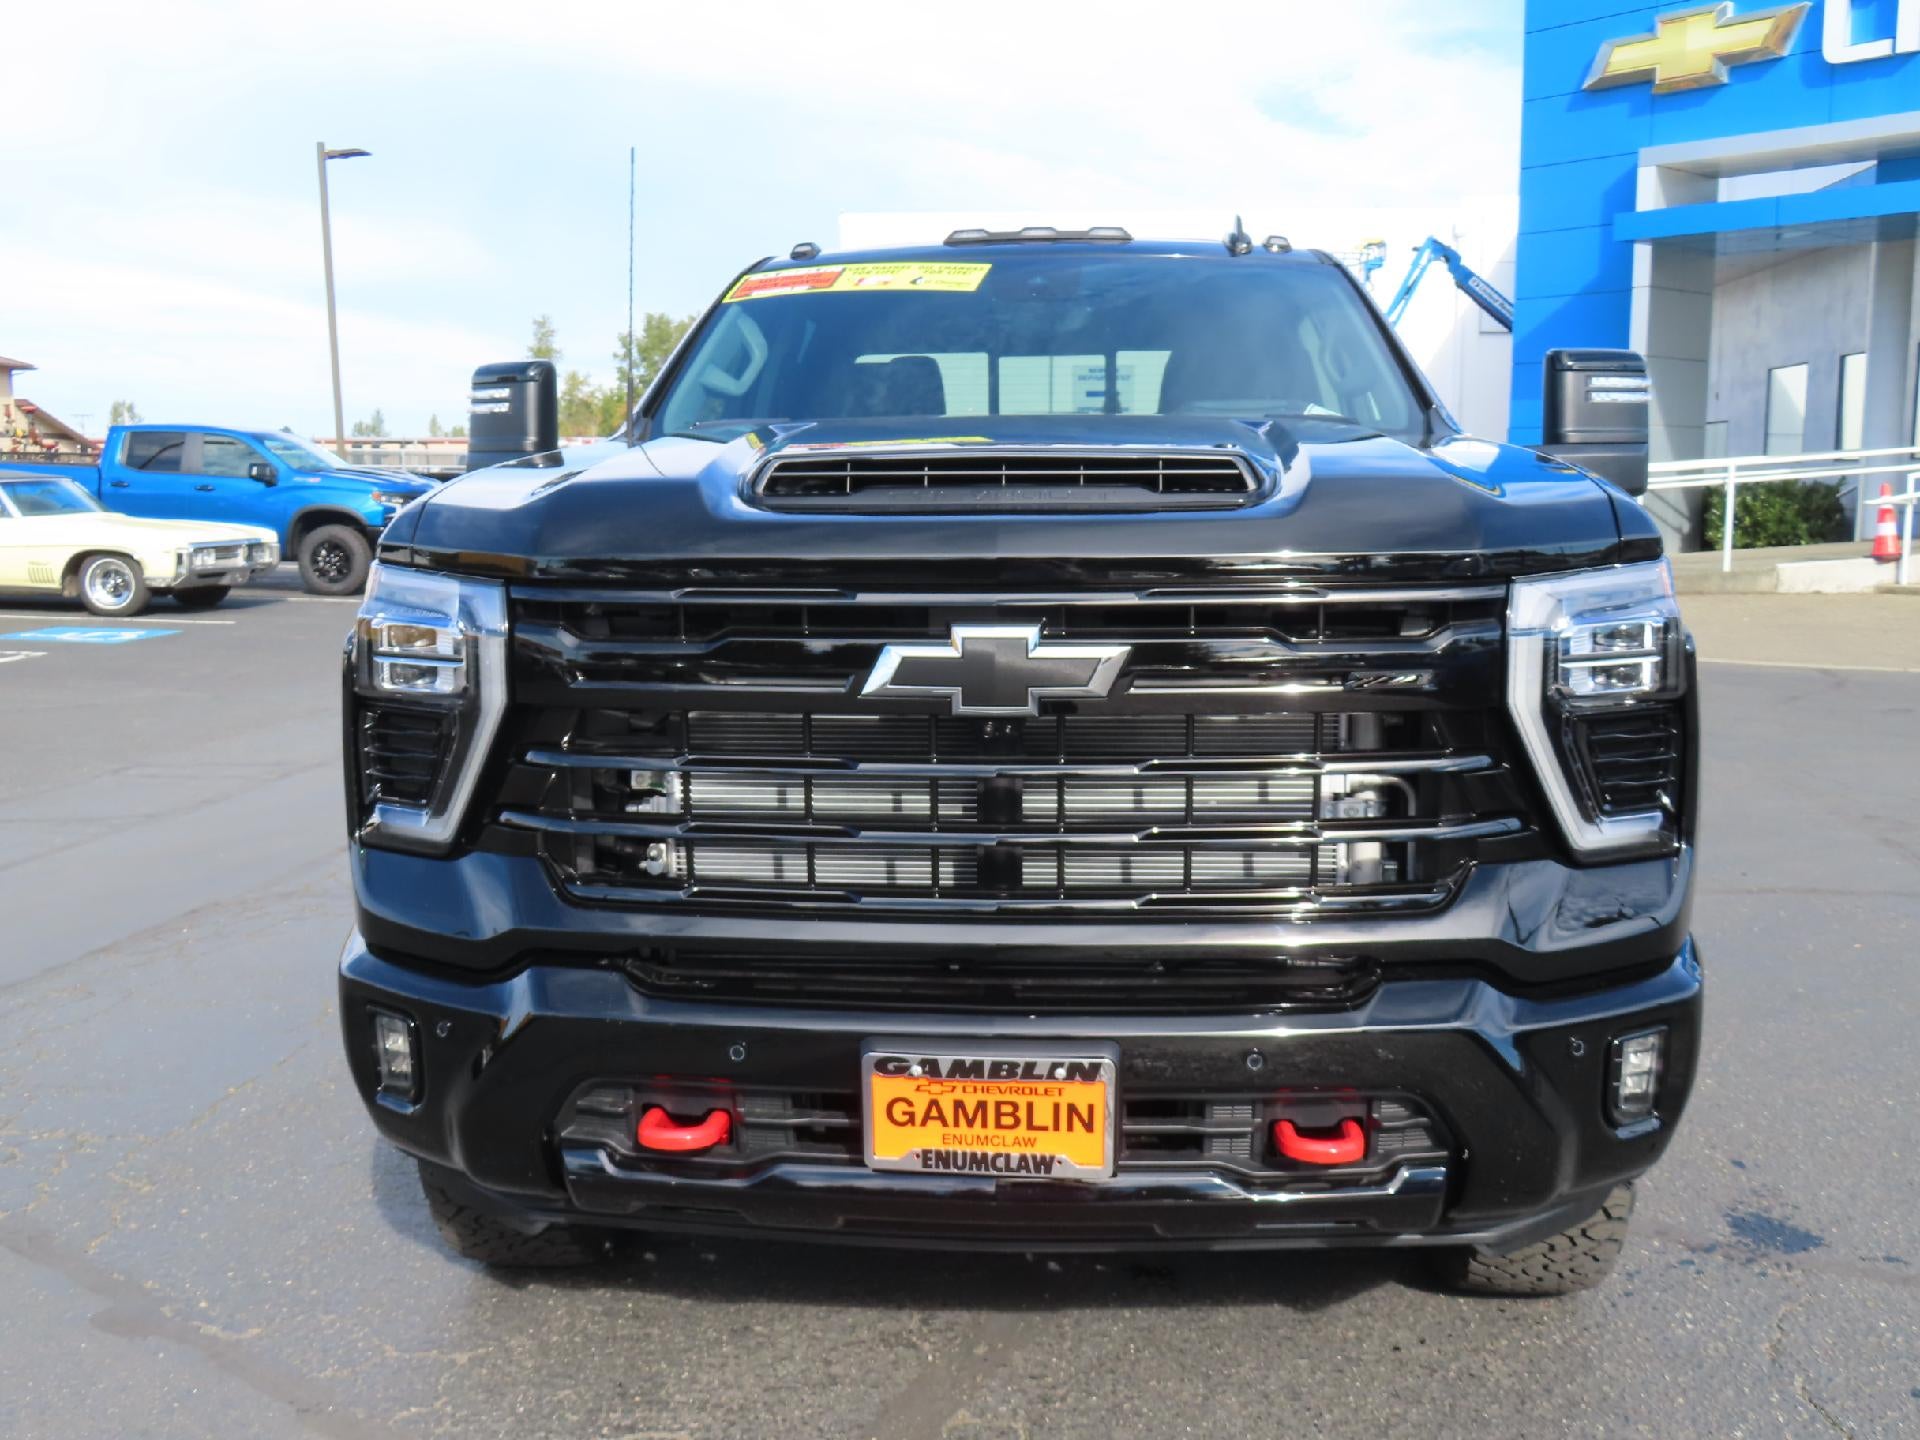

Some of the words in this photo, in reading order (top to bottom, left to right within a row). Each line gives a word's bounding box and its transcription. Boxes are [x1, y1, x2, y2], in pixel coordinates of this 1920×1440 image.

[874, 1056, 1102, 1082] GAMBLIN
[962, 1085, 1065, 1097] CHEVROLET
[886, 1097, 1095, 1134] GAMBLIN
[942, 1133, 1037, 1149] ENUMCLAW
[921, 1149, 1056, 1175] ENUMCLAW
